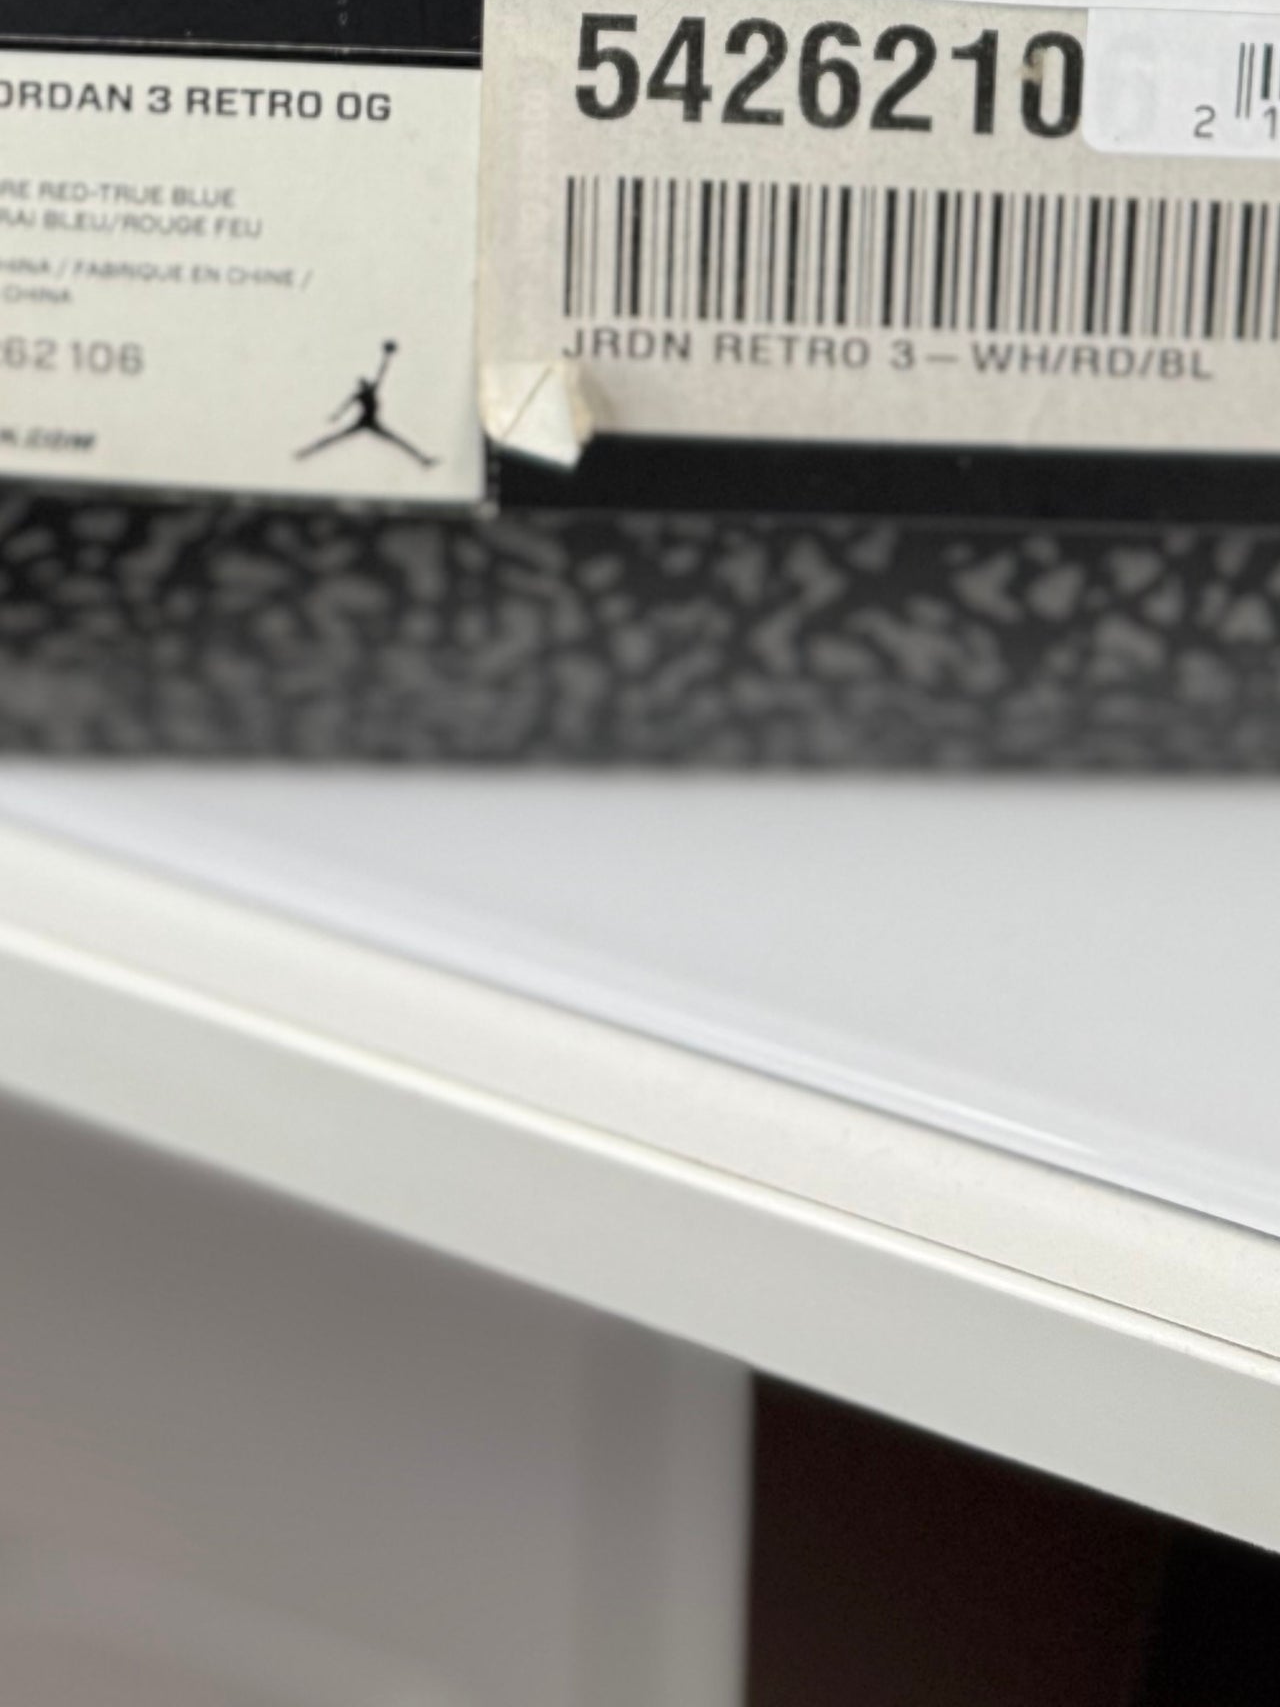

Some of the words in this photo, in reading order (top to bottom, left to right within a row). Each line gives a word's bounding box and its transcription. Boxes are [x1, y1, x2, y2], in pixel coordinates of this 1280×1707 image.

[147, 85, 172, 115] 3
[186, 86, 324, 119] RETRO
[336, 91, 392, 123] OG
[1192, 103, 1218, 141] 2
[171, 186, 236, 209] BLUE
[214, 216, 262, 240] FEU
[562, 326, 693, 364] JRDN
[713, 331, 871, 369] RETRO
